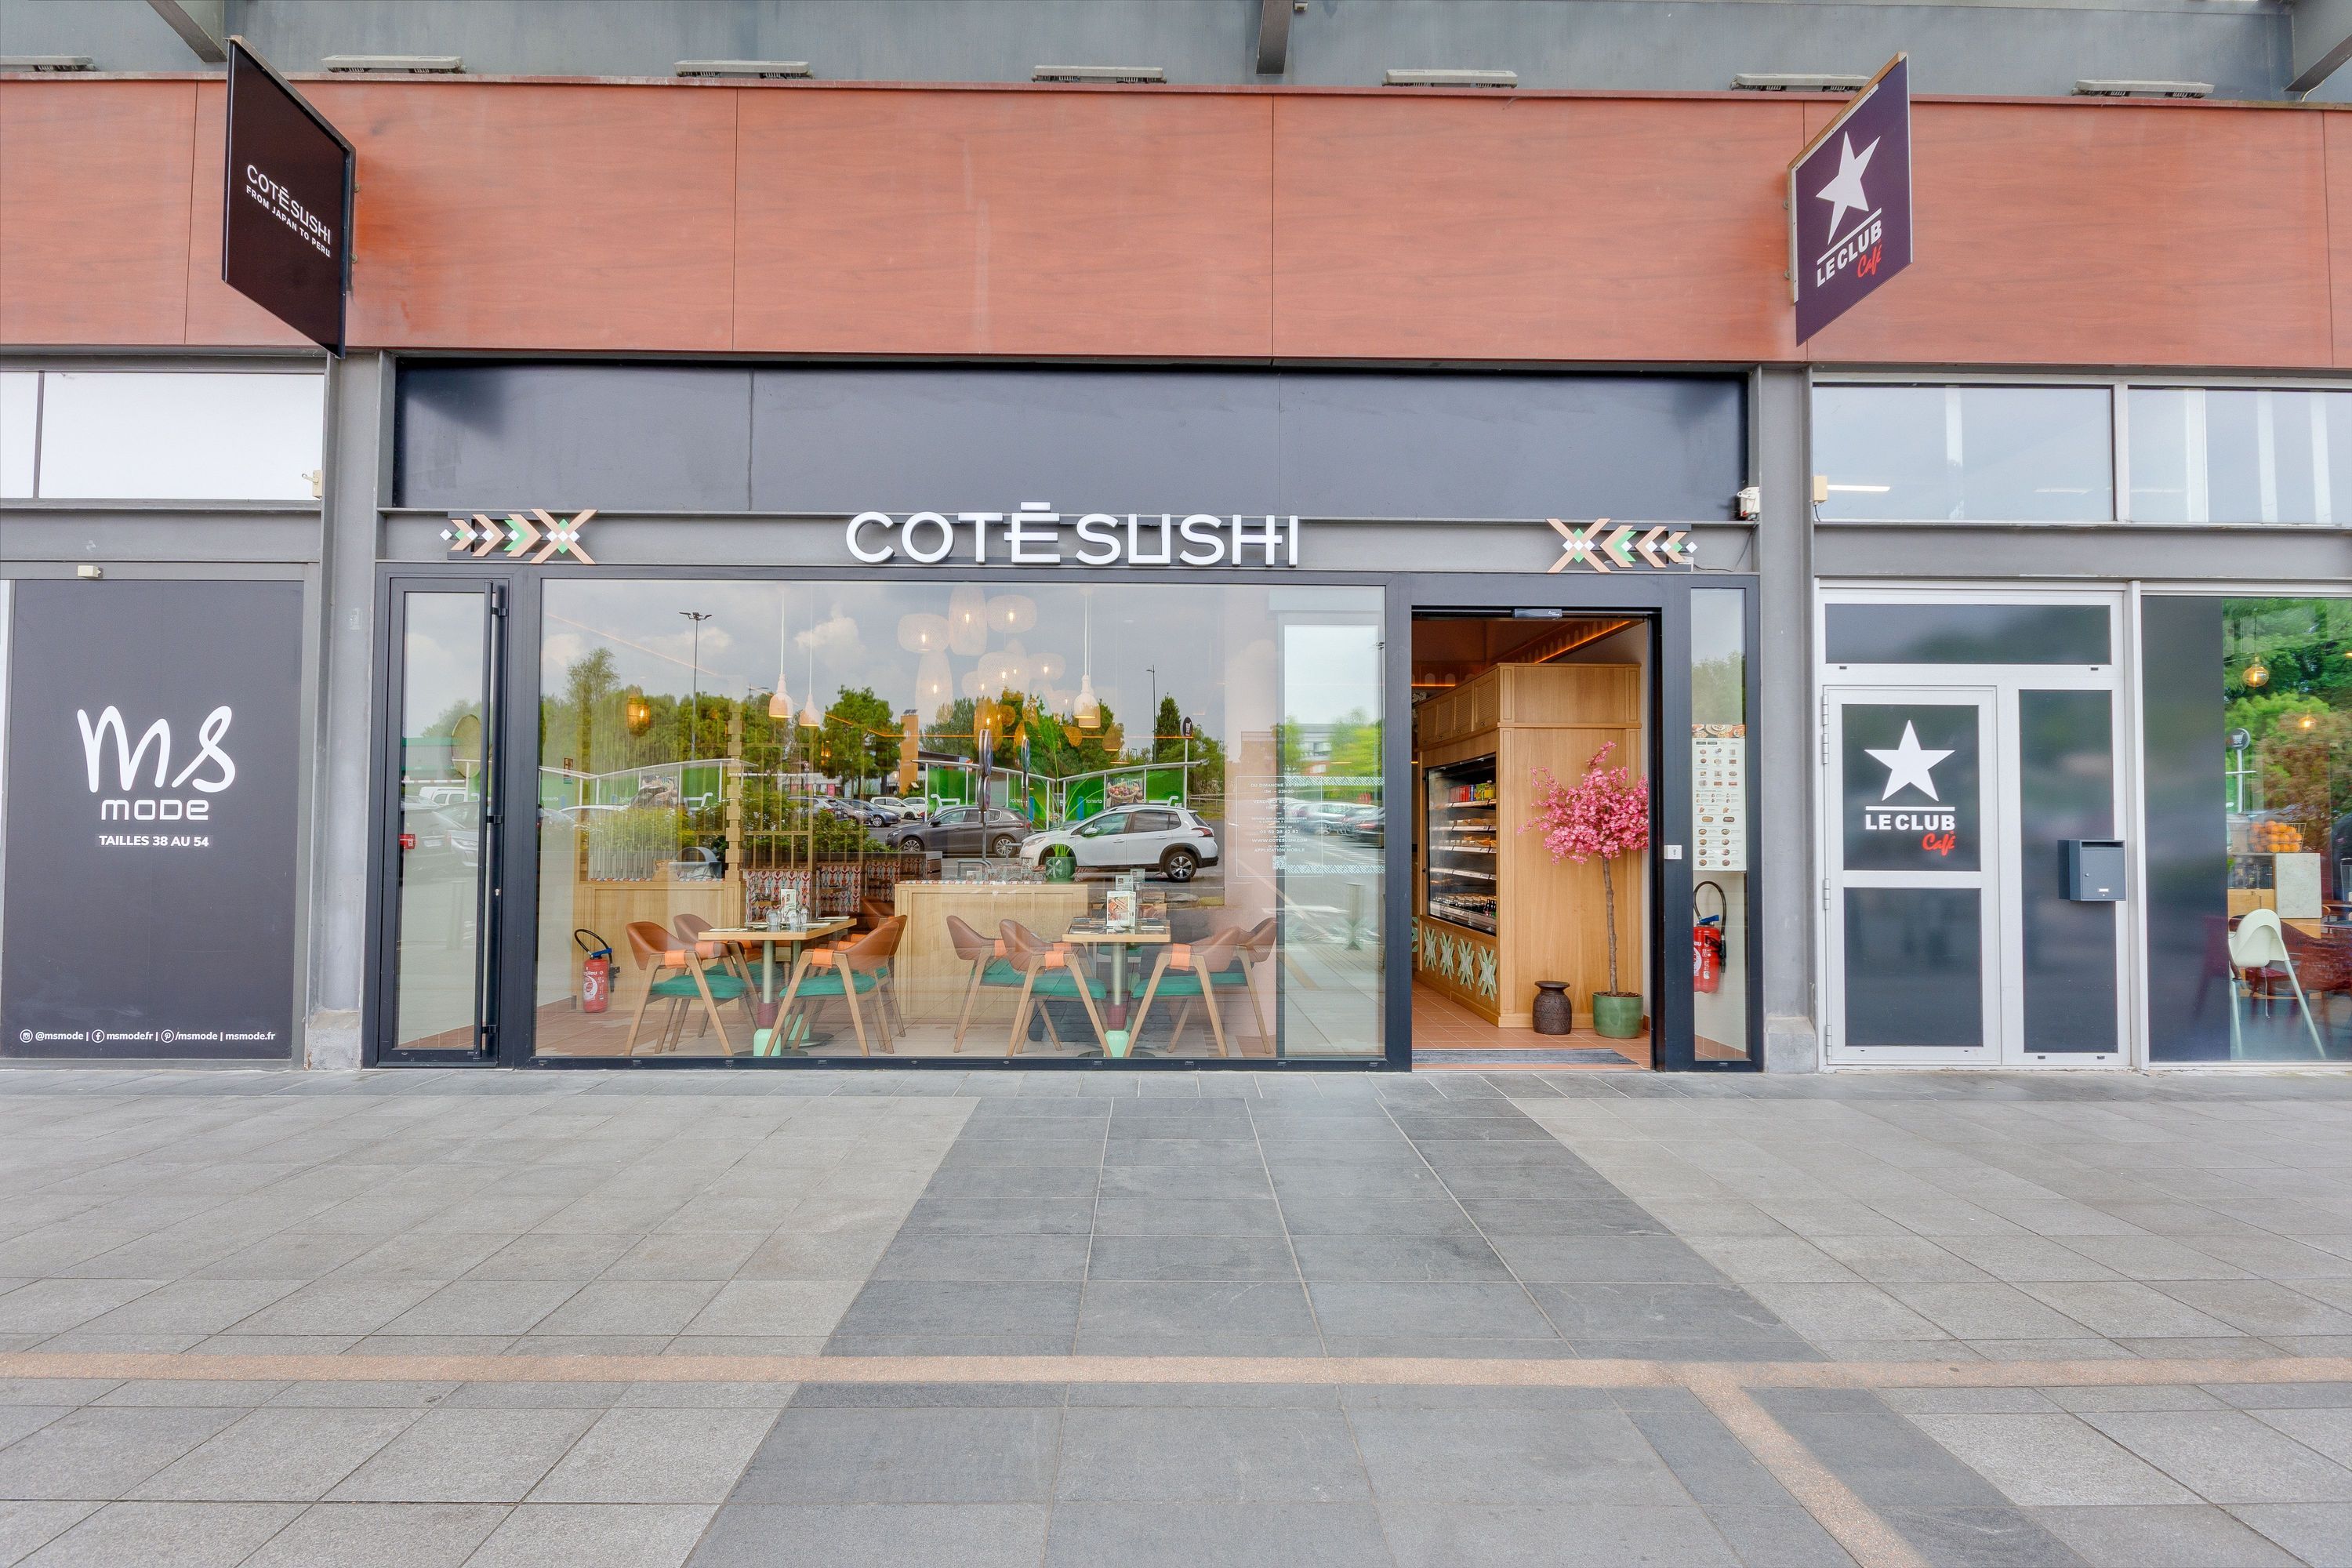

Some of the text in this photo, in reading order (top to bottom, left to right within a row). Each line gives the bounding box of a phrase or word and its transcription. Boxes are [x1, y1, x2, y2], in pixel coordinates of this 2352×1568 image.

[245, 184, 331, 258] FROM JAPAN TO PERU
[99, 835, 209, 847] TAILLES 38 AU 54
[1922, 830, 1956, 856] Café
[35, 1031, 84, 1041] @msmode
[225, 1031, 276, 1040] msmode.fr
